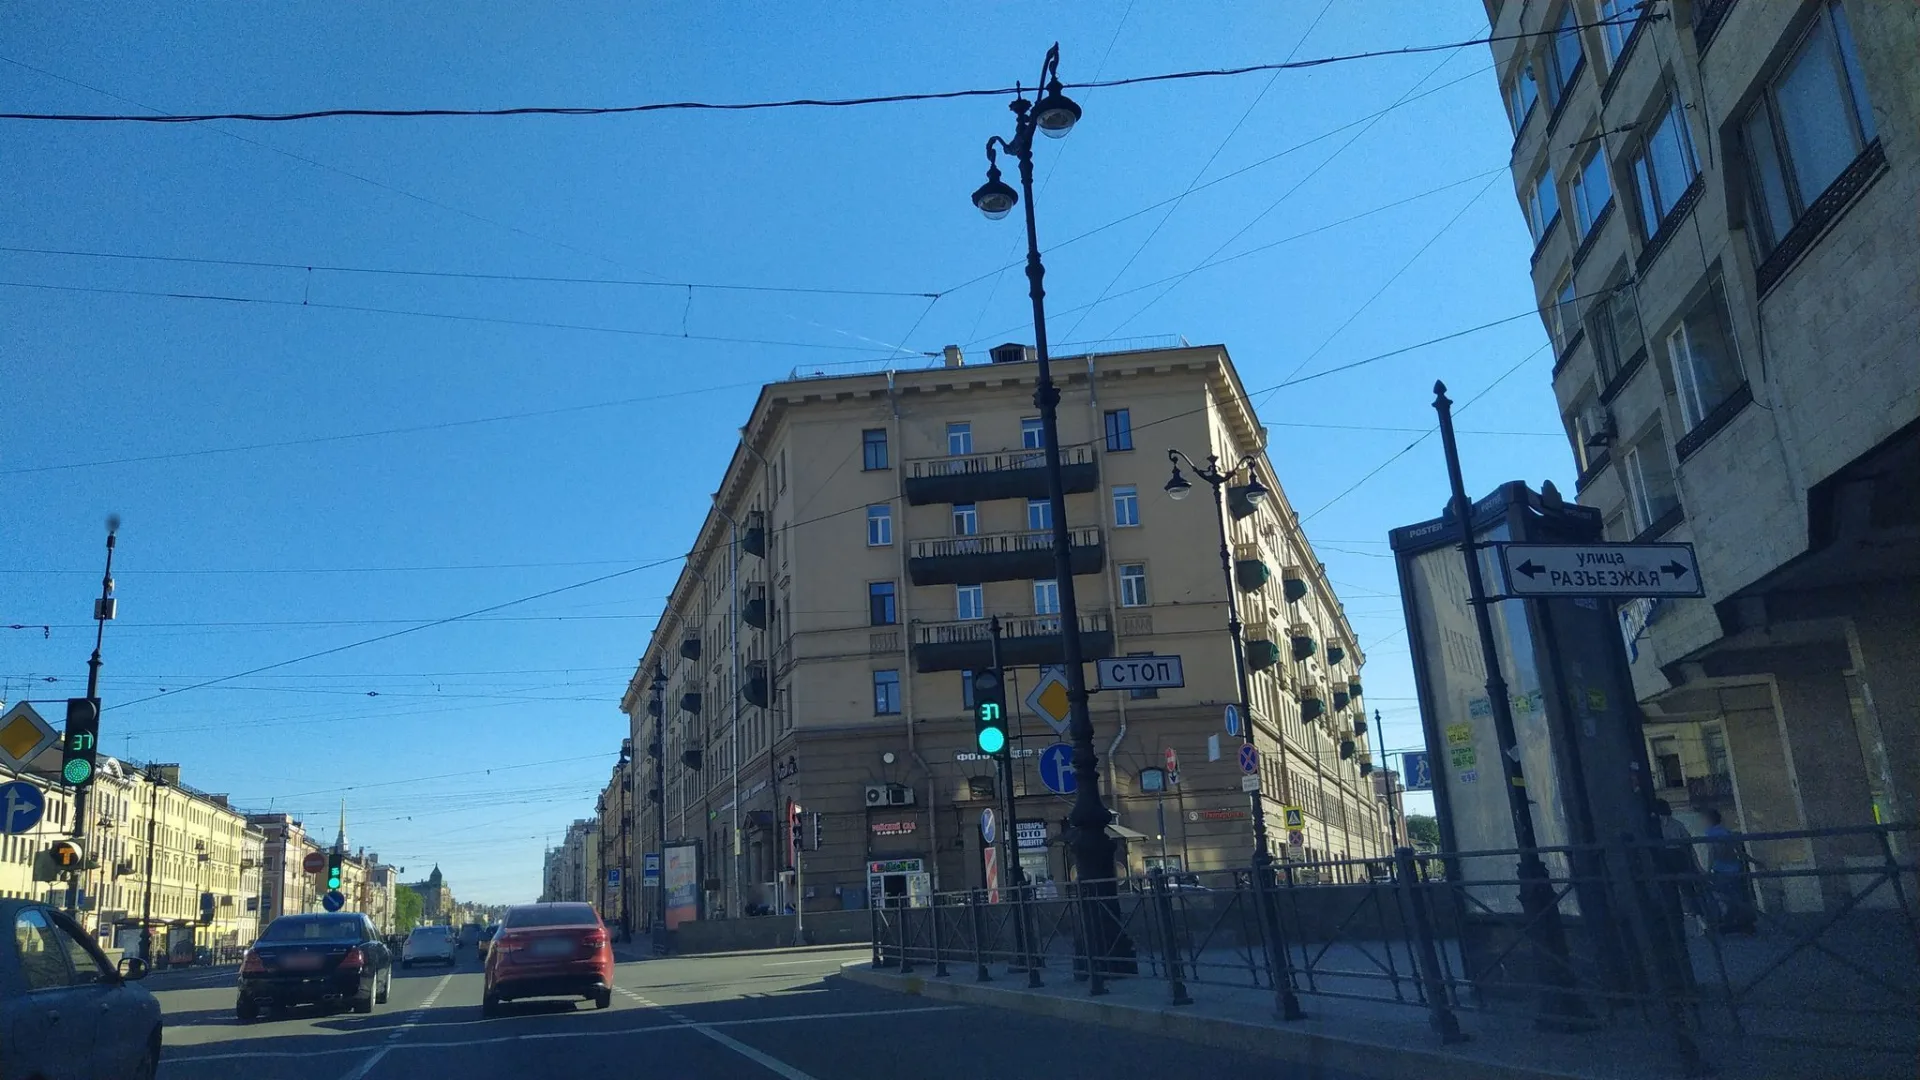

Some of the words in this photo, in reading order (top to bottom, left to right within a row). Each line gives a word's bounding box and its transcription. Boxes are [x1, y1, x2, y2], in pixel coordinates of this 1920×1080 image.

[1409, 522, 1443, 538] POSTER
[1576, 552, 1625, 567] улица
[1550, 570, 1661, 587] РАЗЪЕЗЖАЯ
[1112, 662, 1170, 682] СТОП
[981, 703, 1000, 721] 37
[73, 734, 92, 751] 37
